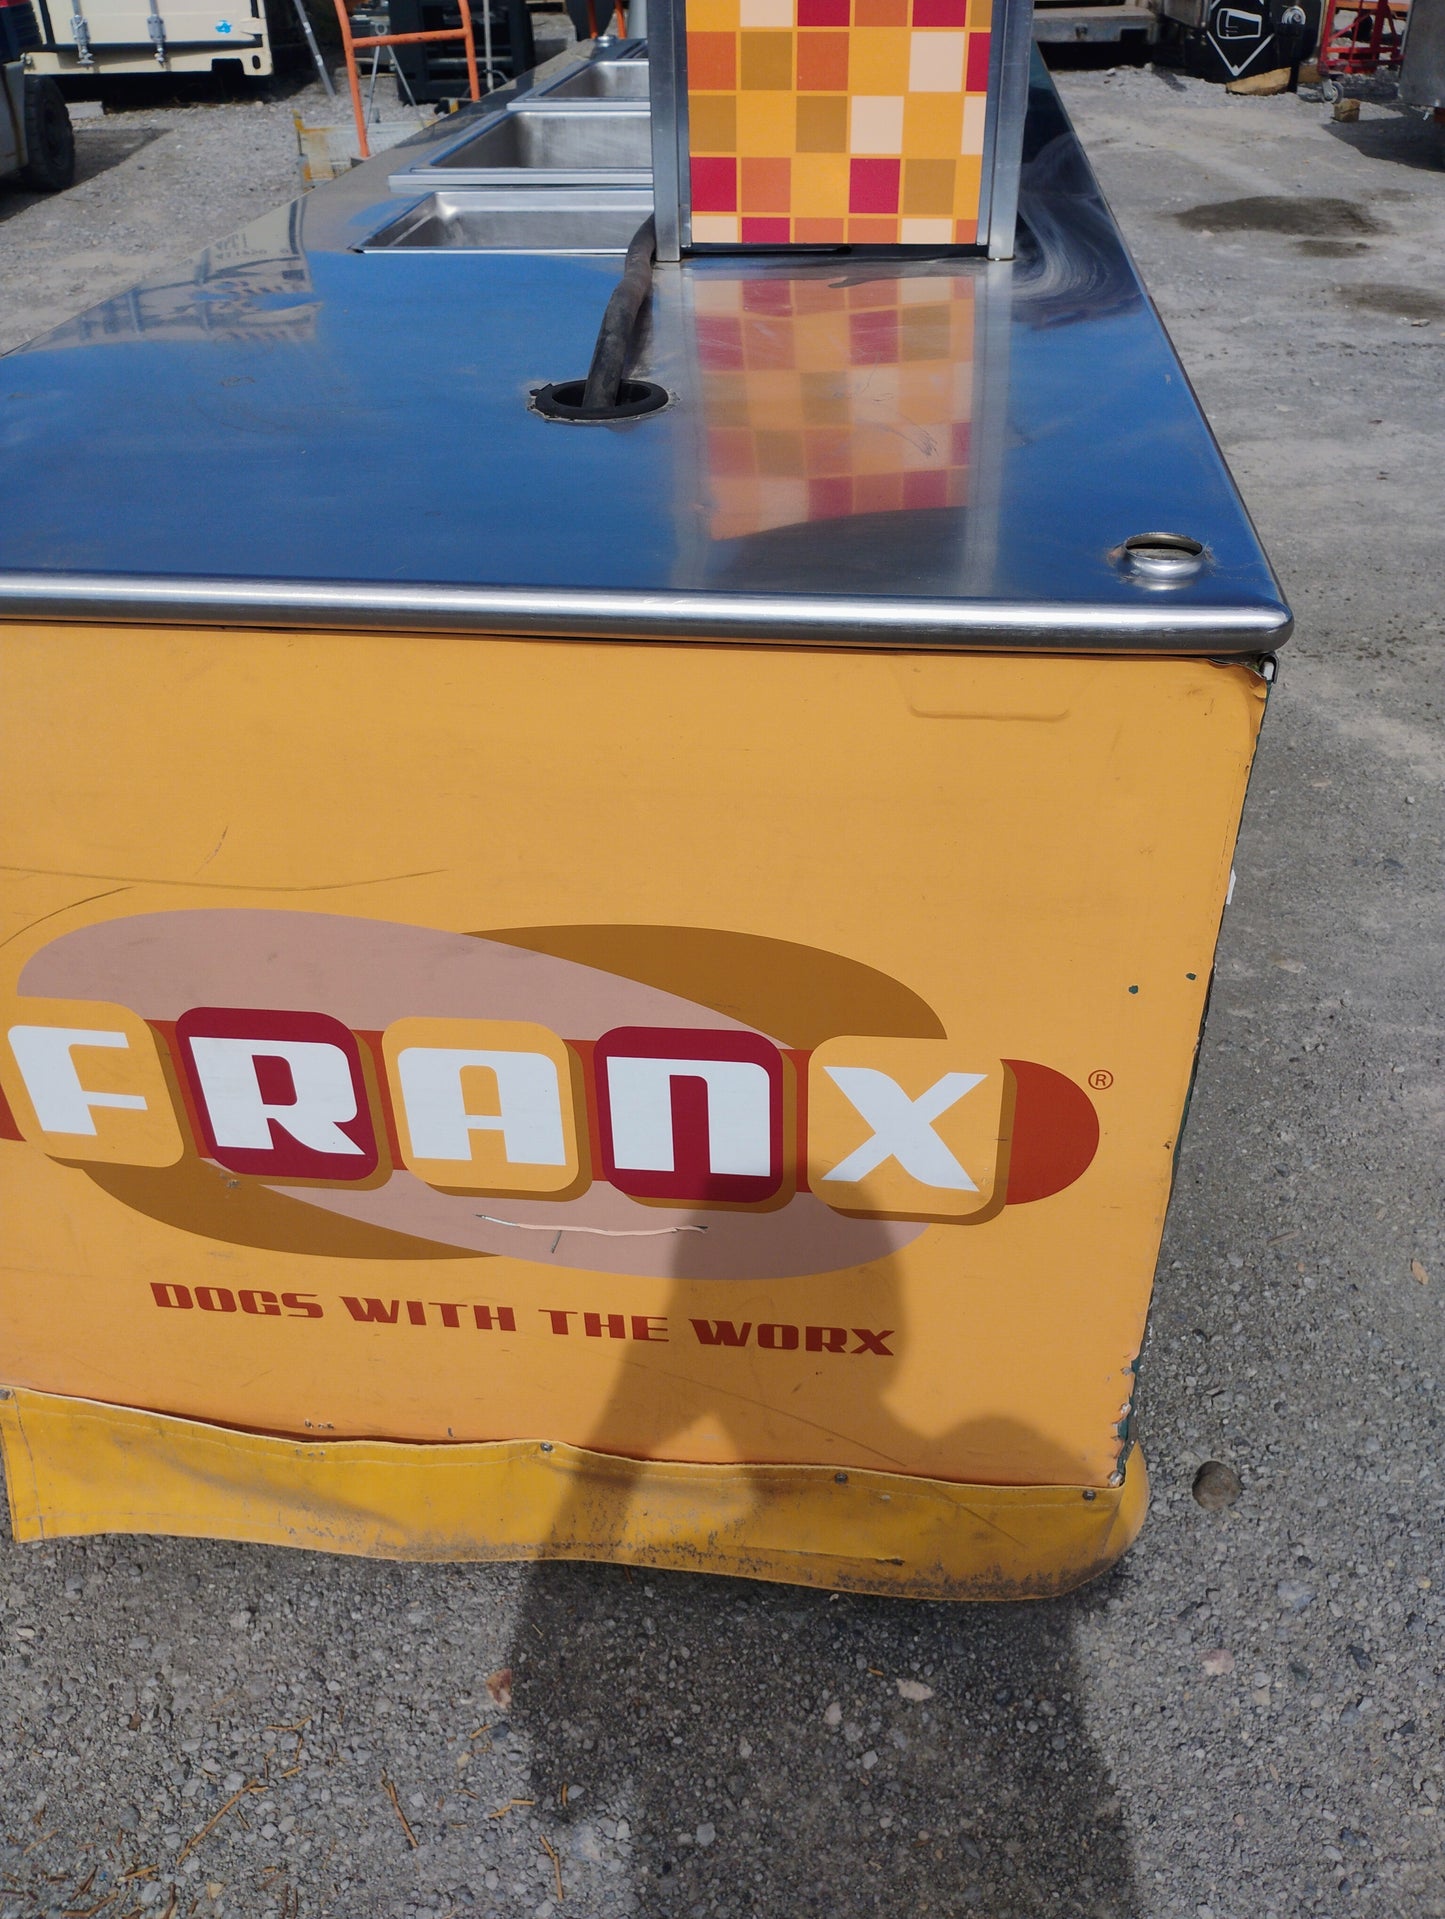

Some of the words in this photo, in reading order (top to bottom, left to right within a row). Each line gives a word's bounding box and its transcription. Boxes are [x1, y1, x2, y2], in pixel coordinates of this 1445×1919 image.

[150, 1282, 324, 1318] DOGS
[339, 1296, 517, 1331] WITH
[538, 1309, 669, 1342] THE
[688, 1319, 895, 1356] WORX
